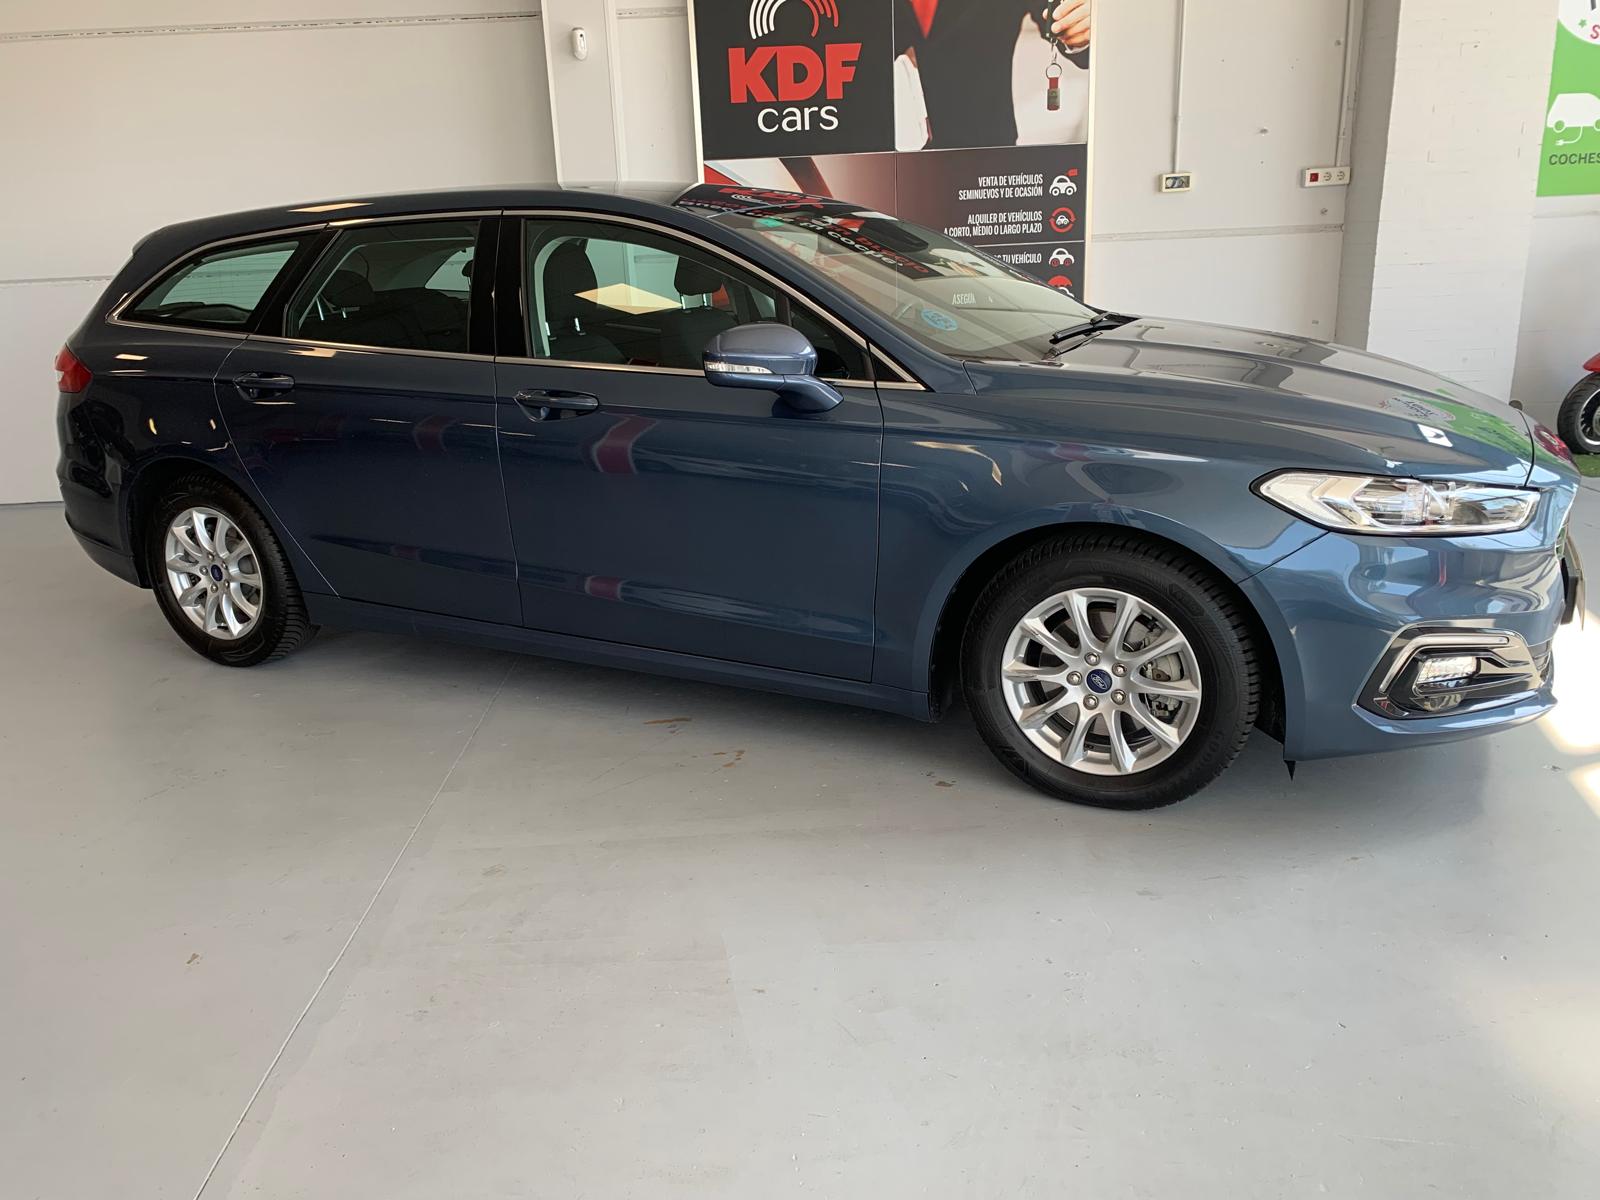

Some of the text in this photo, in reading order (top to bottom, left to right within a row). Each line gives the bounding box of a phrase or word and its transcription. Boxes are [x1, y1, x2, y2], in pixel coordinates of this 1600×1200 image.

[728, 43, 862, 103] KDF
[757, 105, 839, 133] cars
[978, 172, 1043, 187] VENTA DE VEHÍCULOS
[958, 185, 1043, 200] SEMINUEVOS Y DE OCASIÓN
[968, 209, 1042, 225] ALQUILER DE VEHÍCULOS
[949, 226, 972, 238] CORTO,
[973, 225, 993, 236] MEDIO
[994, 225, 999, 235] O
[1000, 224, 1021, 235] LARGO
[1022, 223, 1042, 234] PLAZO
[1011, 251, 1042, 264] VEHÍCULO
